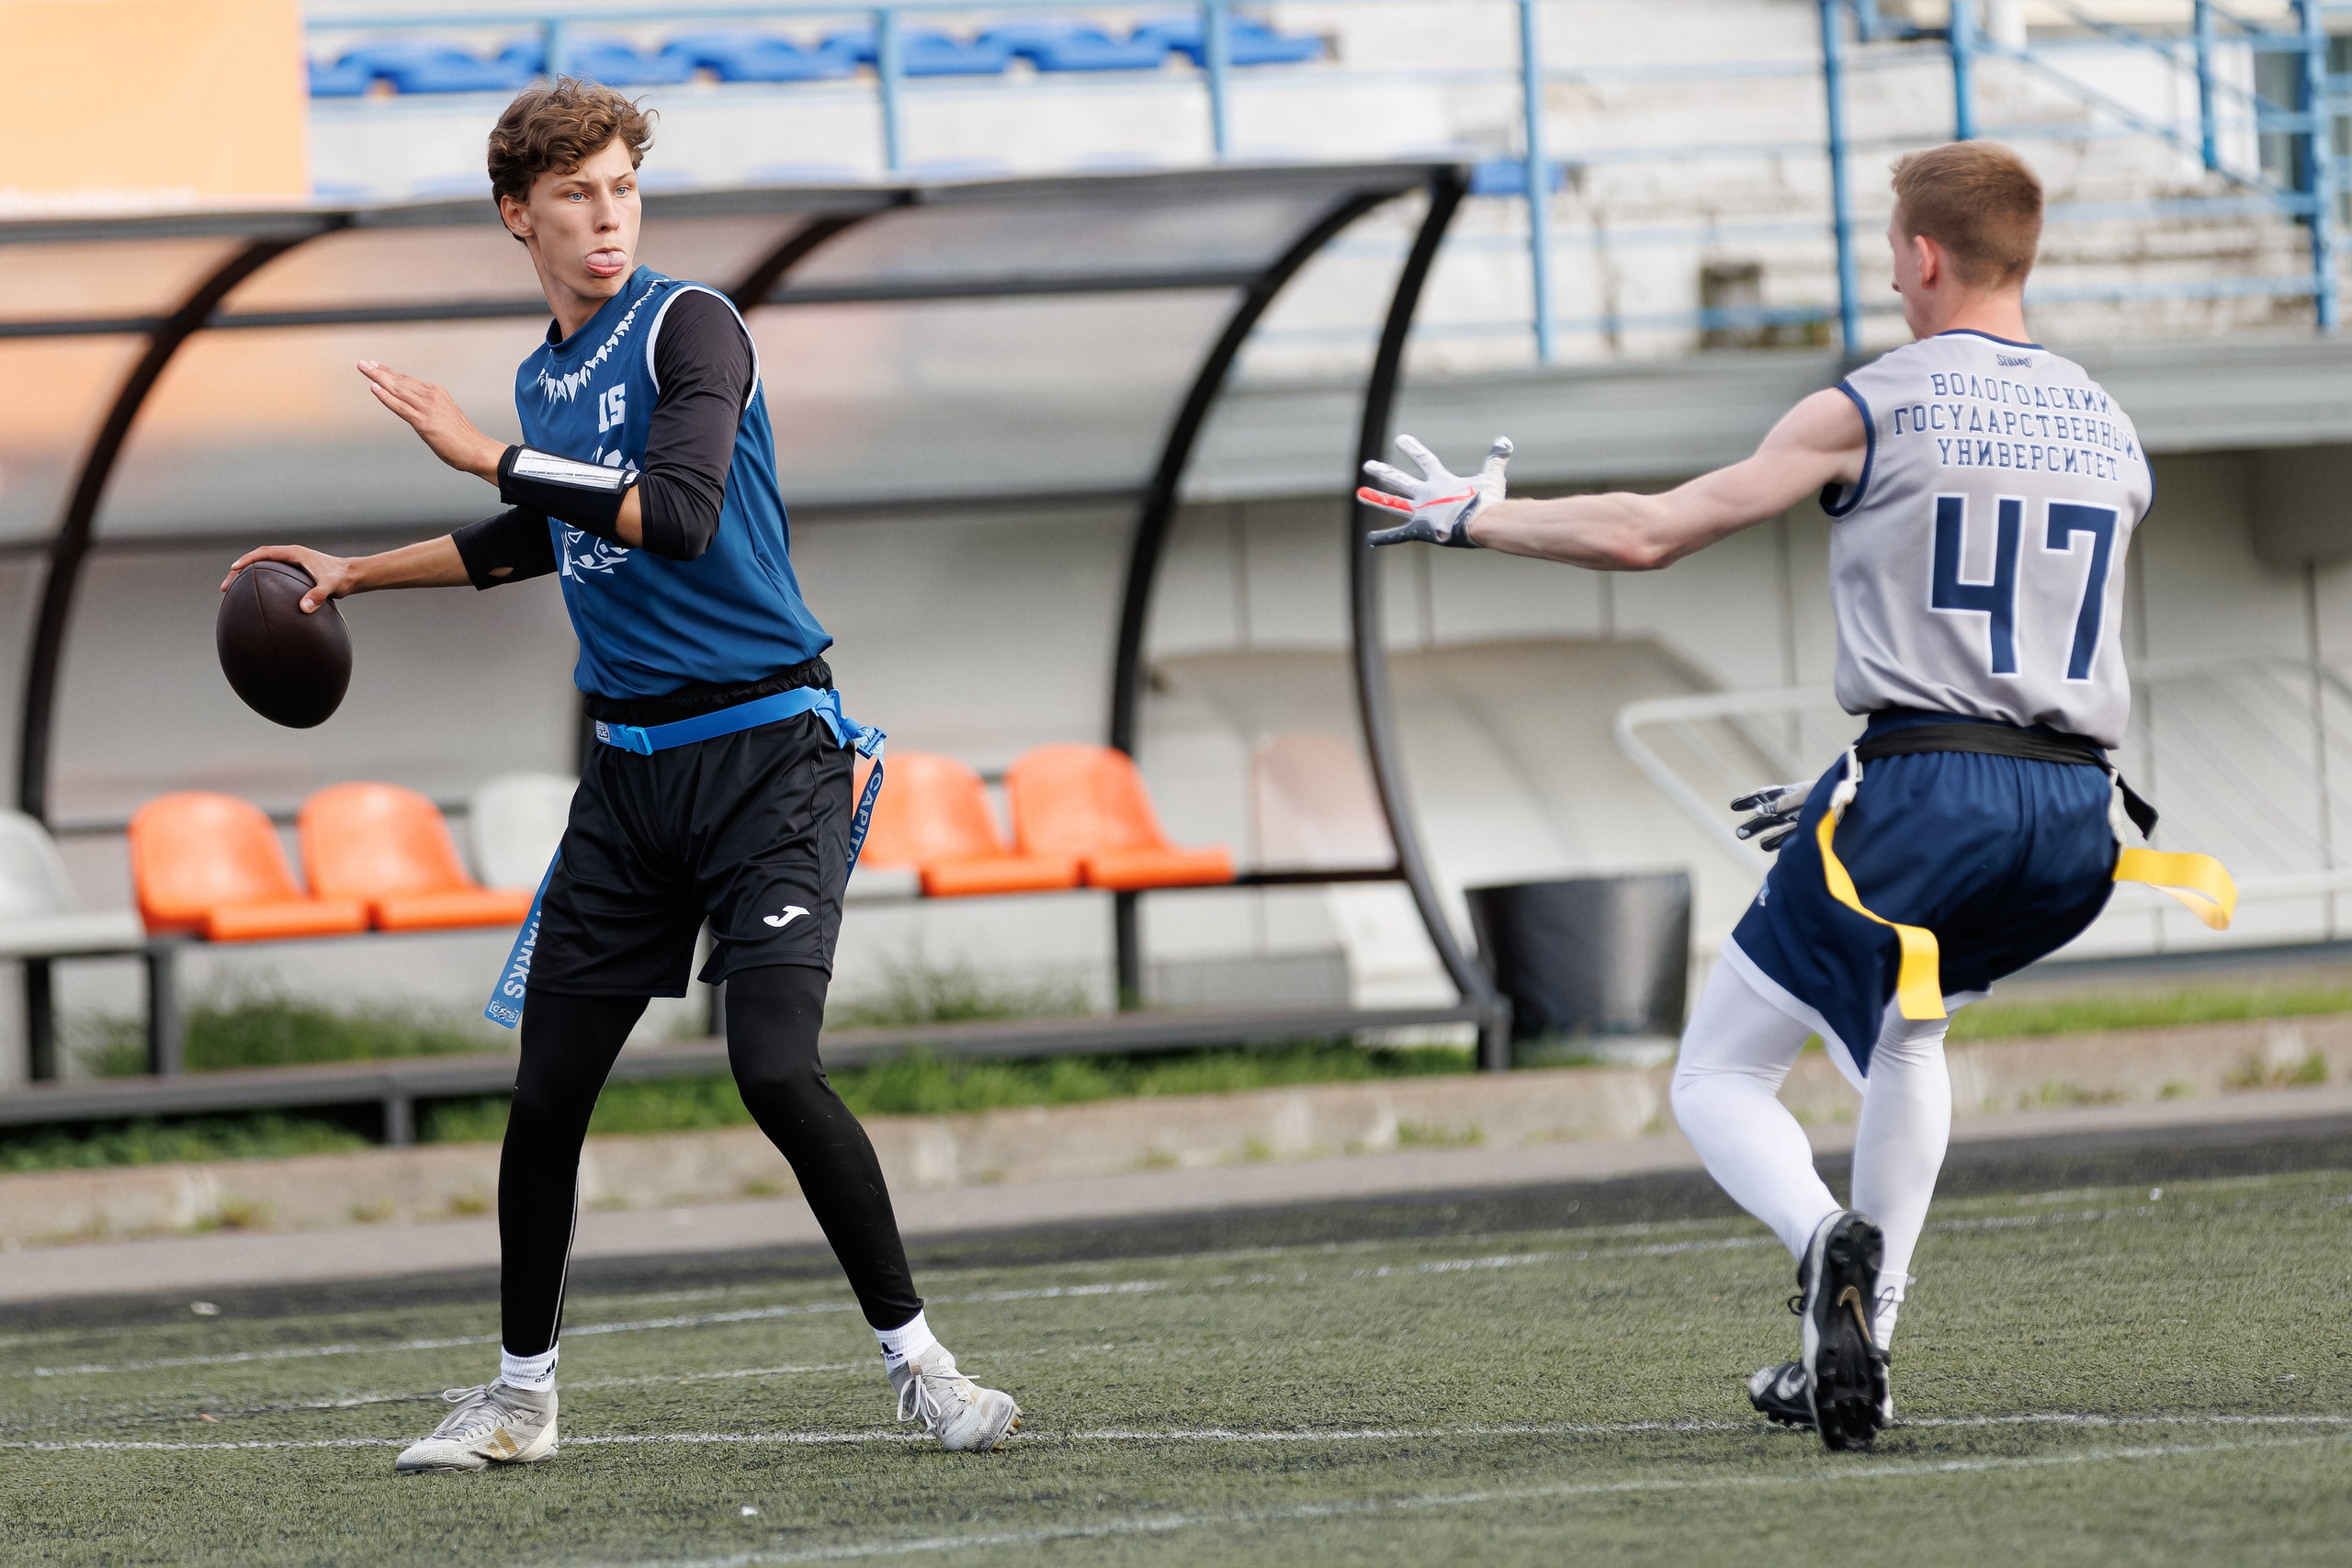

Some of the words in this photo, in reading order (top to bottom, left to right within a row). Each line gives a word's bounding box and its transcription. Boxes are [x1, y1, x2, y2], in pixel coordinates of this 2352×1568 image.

[1929, 372, 2113, 416] ВОЛОГОДСКИЙ
[1894, 403, 2139, 461] ГОСУДАРСТВЕННЫЙ
[1937, 437, 2119, 481] УНИВЕРСИТЕТ
[1929, 492, 2120, 683] 47
[846, 772, 882, 868] CAPITA
[503, 910, 542, 999] ARKS
